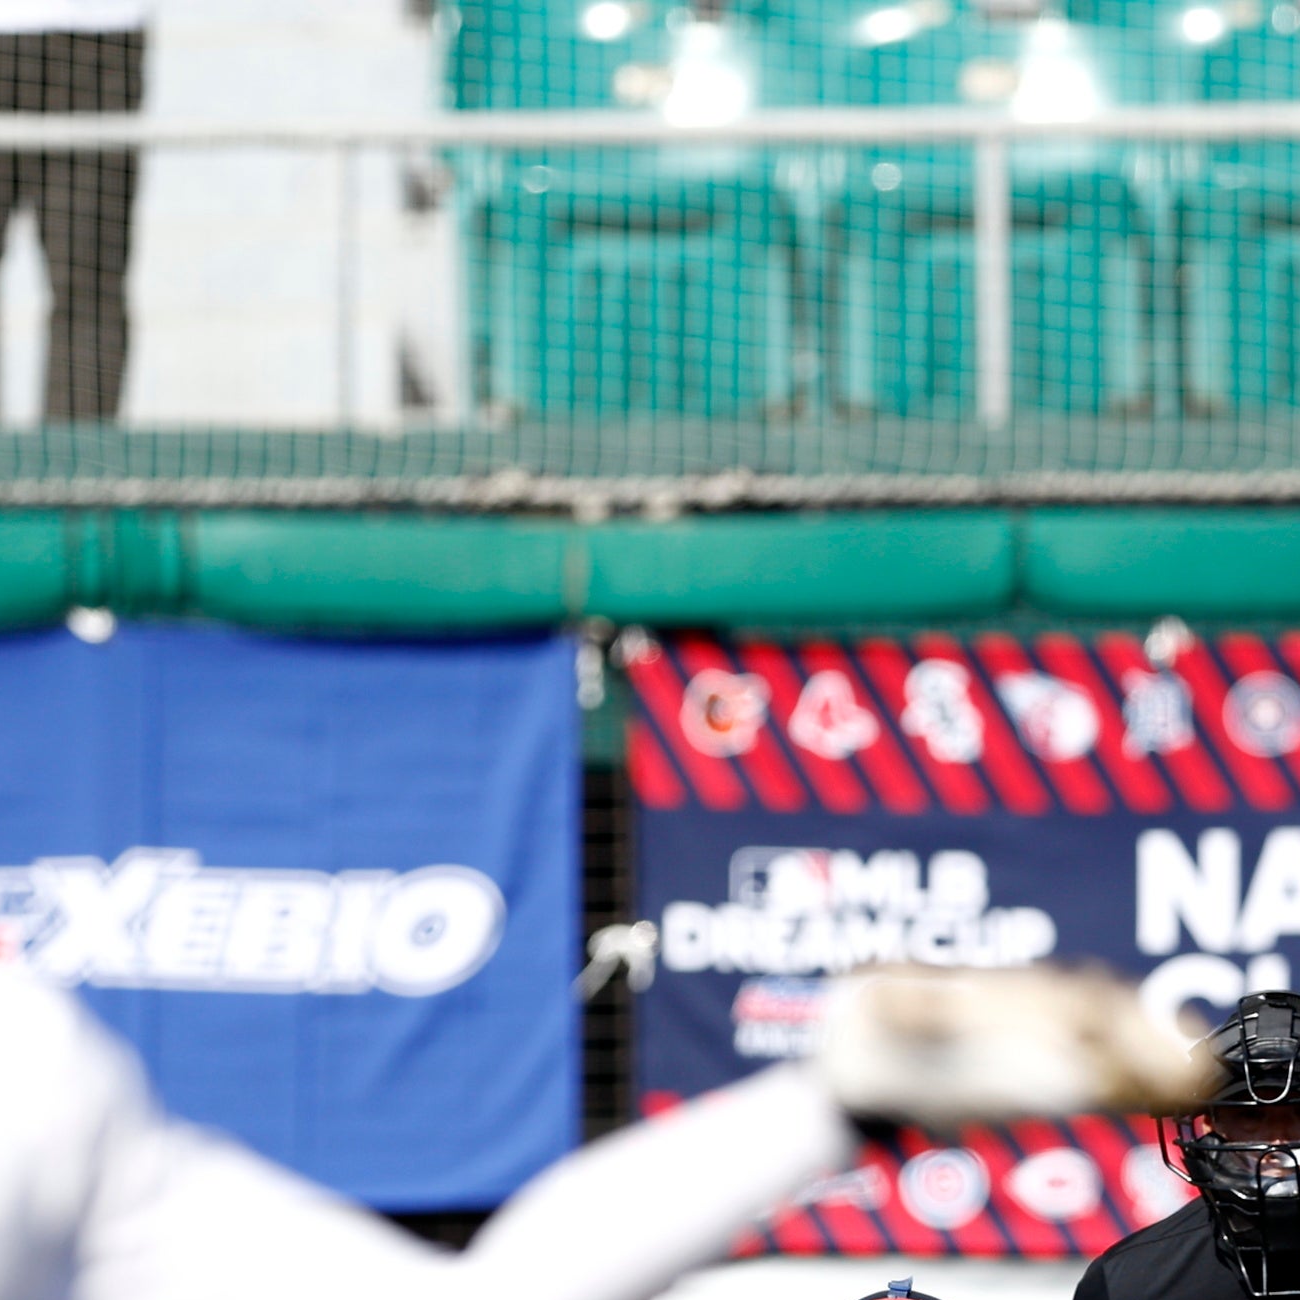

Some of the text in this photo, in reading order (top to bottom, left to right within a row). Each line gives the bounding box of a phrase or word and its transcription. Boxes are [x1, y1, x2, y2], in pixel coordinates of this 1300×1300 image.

[828, 848, 991, 914] MLB
[25, 846, 506, 998] XEBIO
[661, 901, 1058, 974] DREAM CUP
